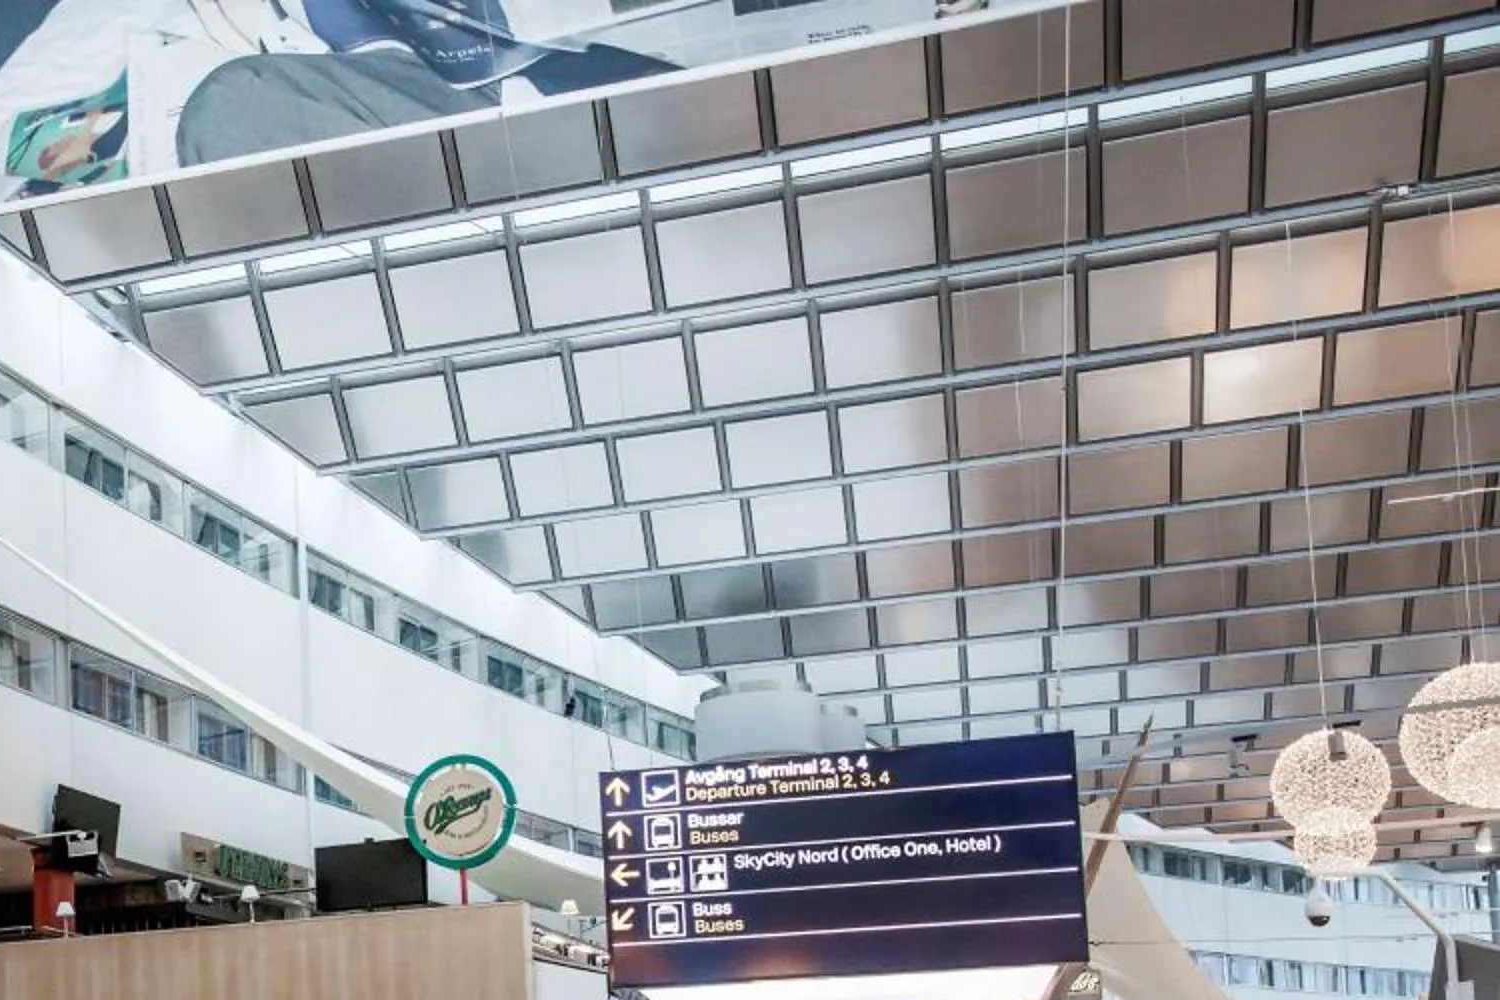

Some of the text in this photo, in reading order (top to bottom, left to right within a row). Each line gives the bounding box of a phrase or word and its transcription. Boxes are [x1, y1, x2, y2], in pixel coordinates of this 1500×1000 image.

[685, 765, 746, 786] Avgång
[748, 758, 818, 779] Terminal
[819, 757, 836, 775] 2,
[856, 755, 869, 770] 4
[685, 770, 891, 803] Departure Terminal 2, 3, 4
[687, 812, 745, 829] Bussar
[689, 830, 740, 845] Buses
[733, 851, 795, 871] SkyCity
[798, 846, 839, 865] Nord
[903, 841, 944, 858] One,
[692, 901, 733, 917] Buss
[694, 919, 745, 934] Buses
